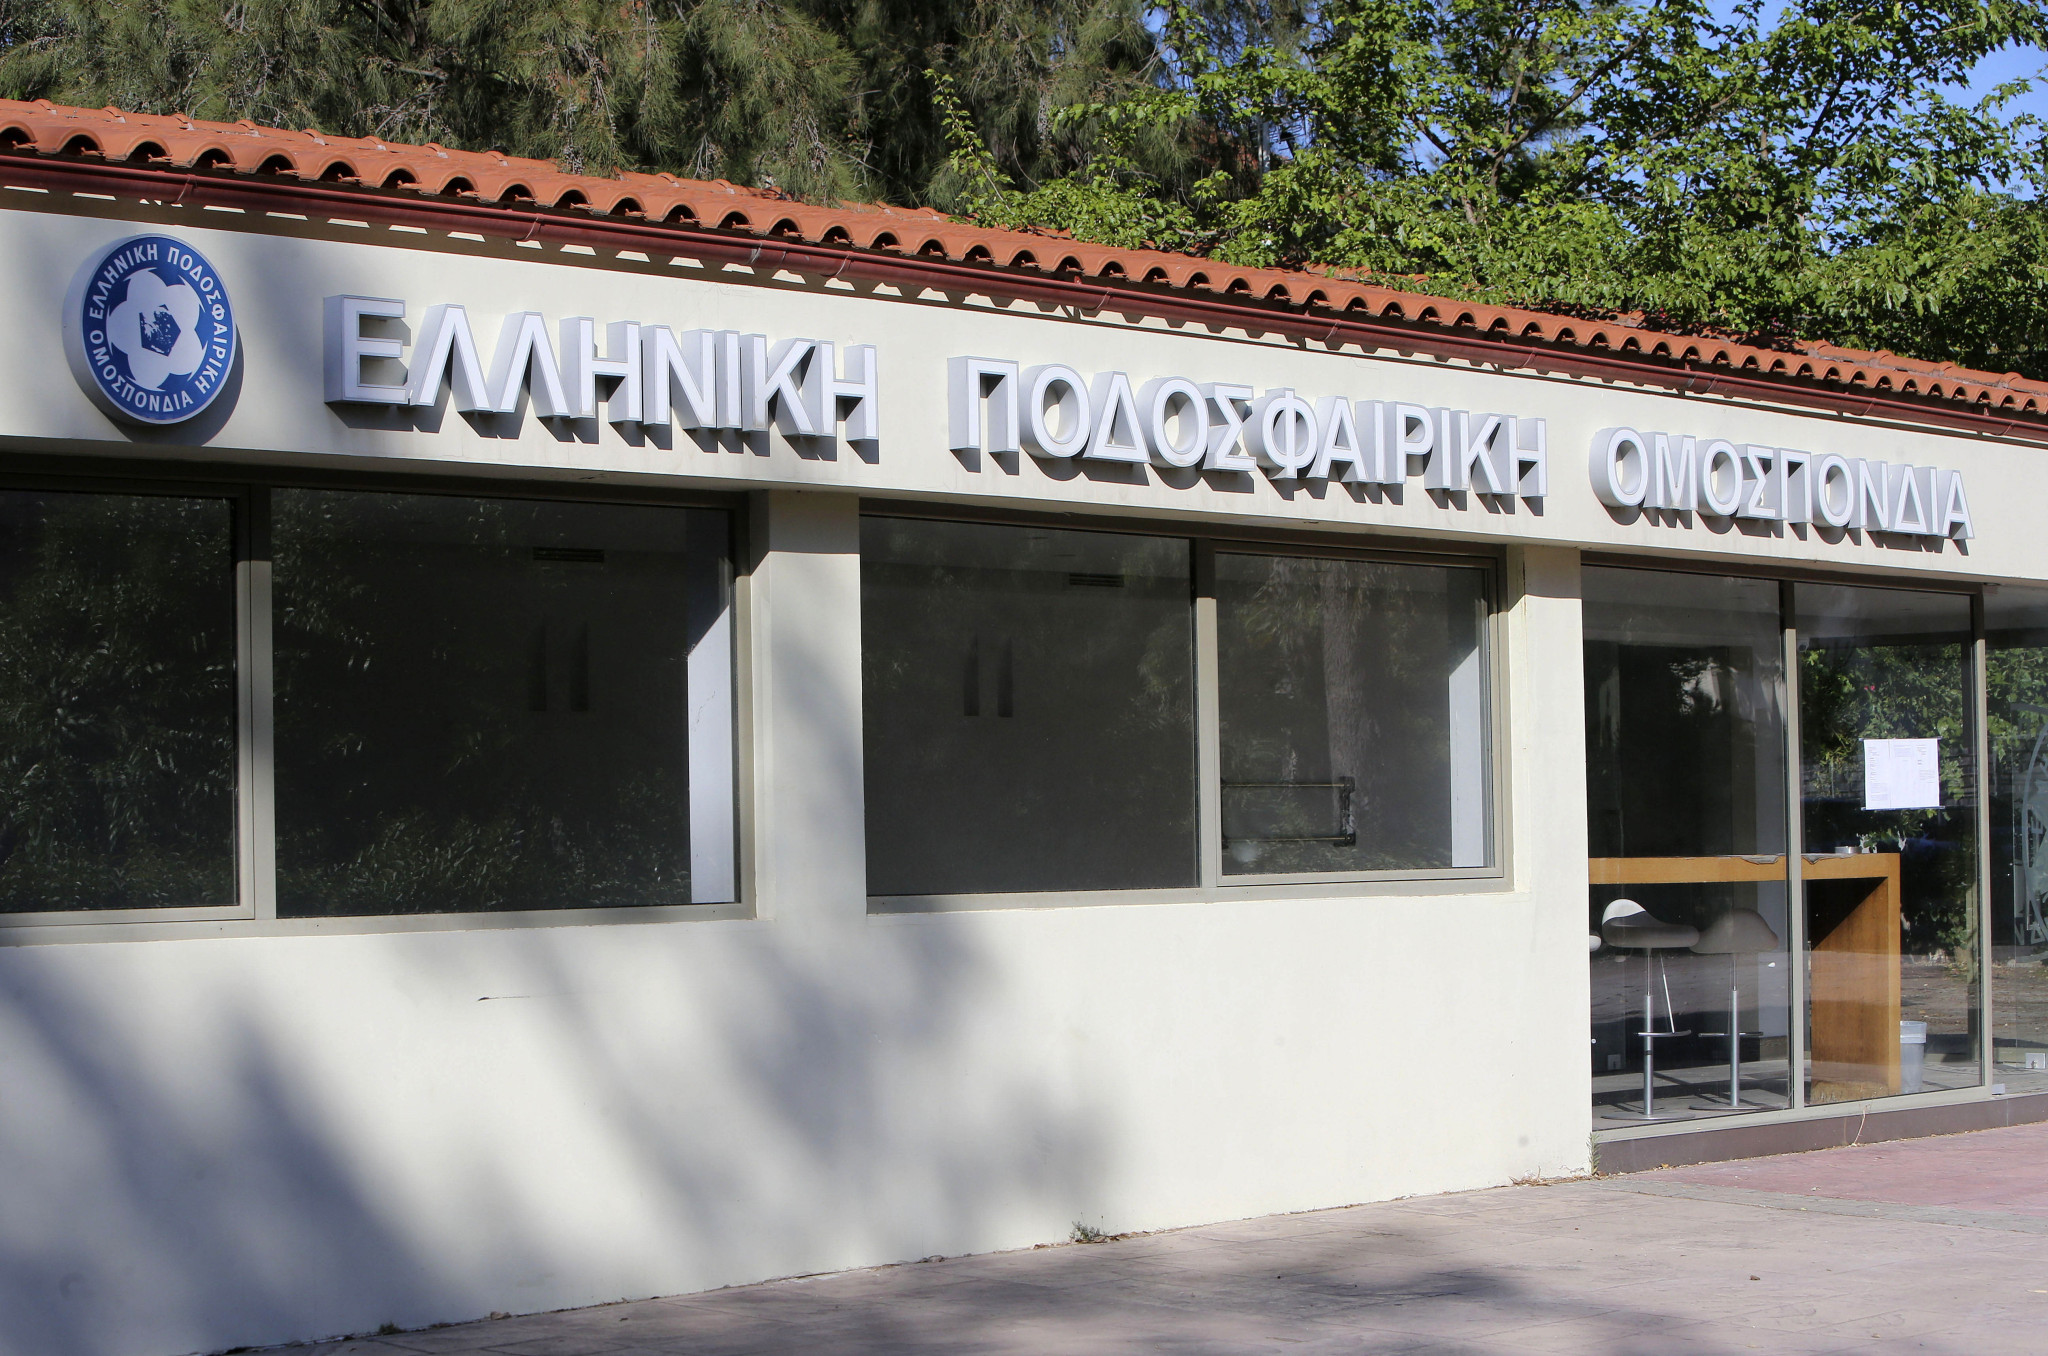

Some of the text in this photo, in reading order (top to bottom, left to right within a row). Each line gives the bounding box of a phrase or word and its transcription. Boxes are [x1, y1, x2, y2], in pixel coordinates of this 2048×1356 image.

[89, 243, 229, 413] ΕΛΛΗΝΙΚΗ ΠΟΔΟΣΦΑΙΡΙΚΗ ΟΜΟΣΠΟΝΔΙΑ
[338, 294, 1975, 540] ΕΛΛΗΝΙΚΗ ΠΟΔΟΣΦΑΙΡΙΚΗ ΟΜΟΣΠΟΝΔΙΑ
